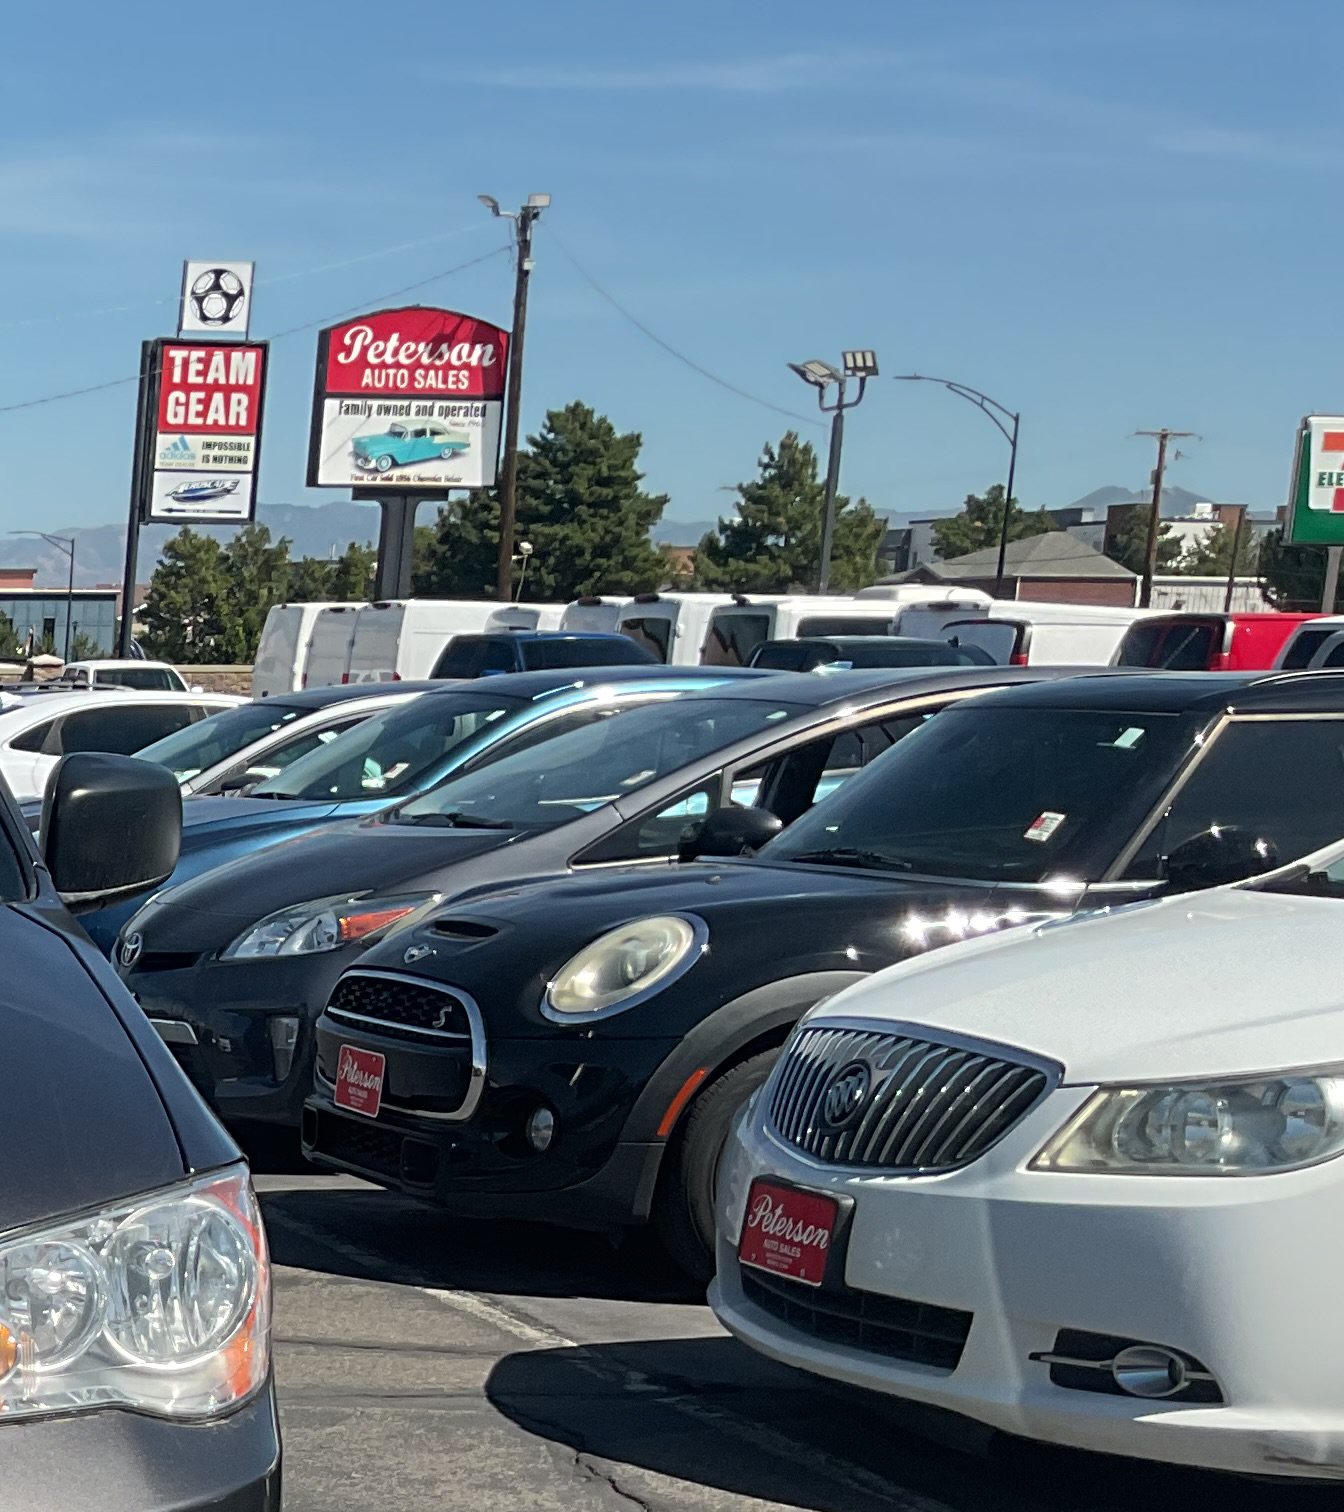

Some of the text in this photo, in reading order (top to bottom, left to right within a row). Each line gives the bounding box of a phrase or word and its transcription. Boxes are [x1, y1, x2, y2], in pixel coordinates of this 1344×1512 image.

[337, 325, 497, 368] Peterson
[169, 350, 256, 385] TEAM
[361, 368, 470, 390] AUTO SALES
[166, 390, 249, 426] GEAR
[338, 400, 487, 420] Family owned and operated
[201, 441, 251, 452] IMPOSSIBLE
[201, 454, 249, 465] IS NOTHING
[747, 1194, 830, 1250] Peterson
[780, 1243, 801, 1258] SALES
